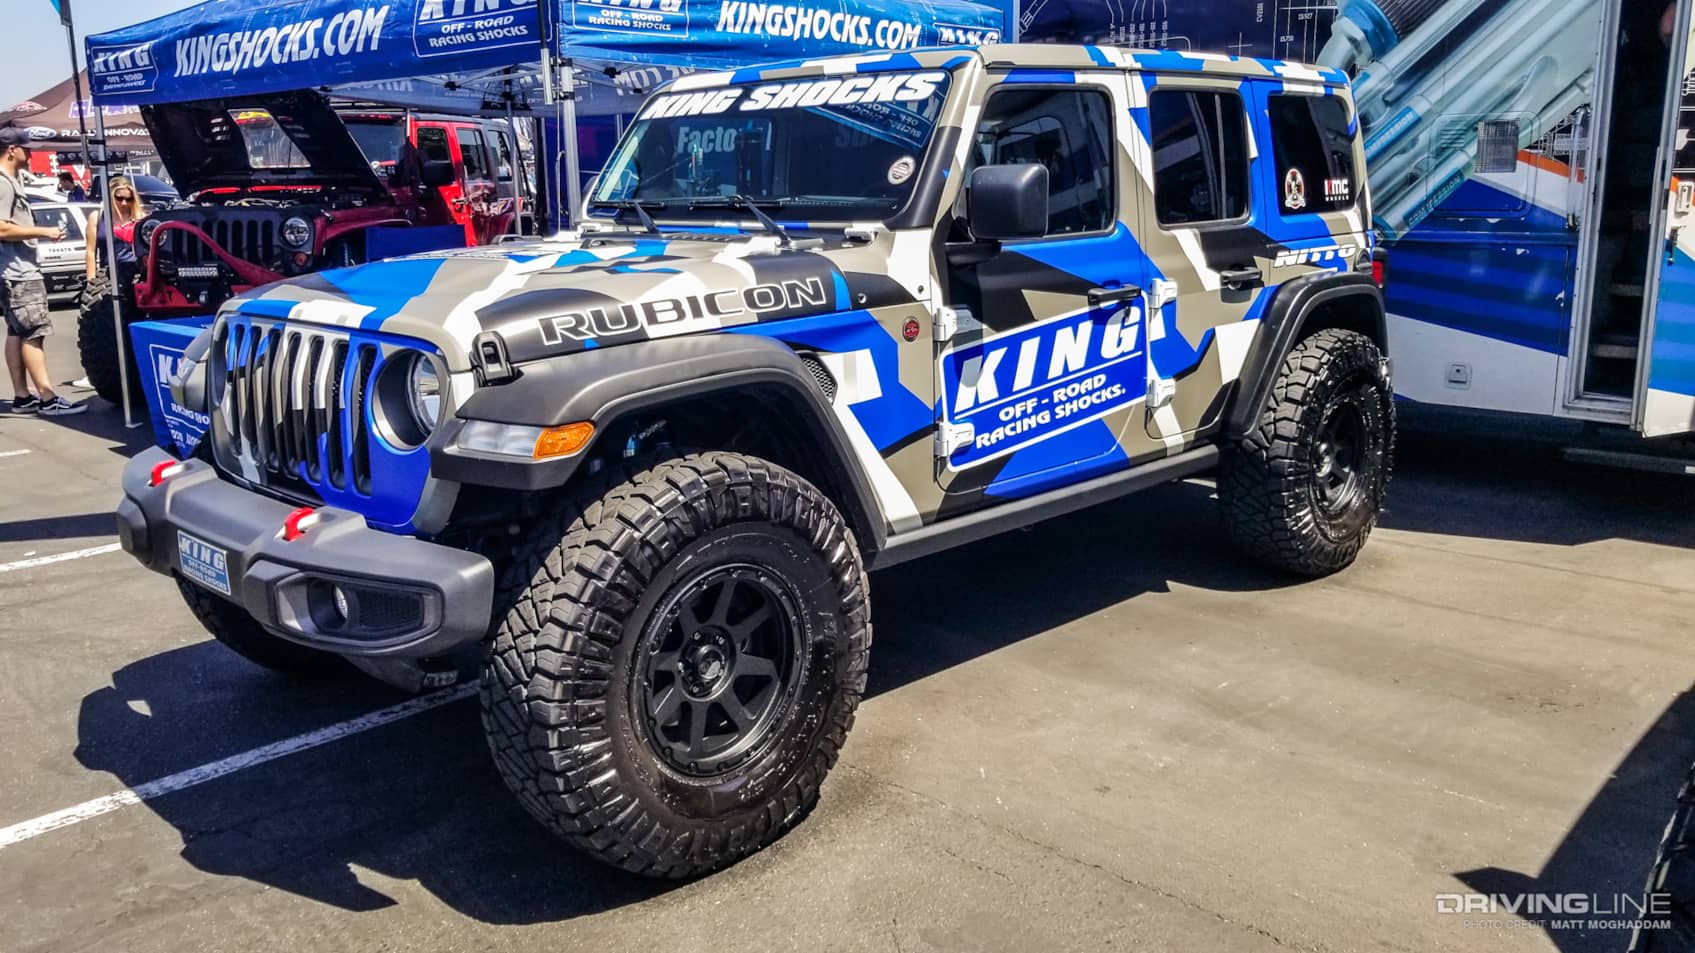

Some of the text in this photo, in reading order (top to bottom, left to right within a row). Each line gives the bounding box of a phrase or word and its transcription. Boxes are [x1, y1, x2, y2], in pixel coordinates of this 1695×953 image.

[419, 0, 537, 20] KIN
[441, 23, 465, 34] OFF
[474, 15, 514, 29] ROAD
[588, 16, 672, 31] RACING SHOCKS
[601, 9, 623, 19] OFF
[631, 12, 664, 22] ROAD
[716, 1, 921, 49] KINGSHOCKS.COM
[174, 5, 390, 77] KINGSHOCKS.COM
[428, 25, 529, 48] RACING SHOCKS
[639, 88, 745, 121] KING
[740, 71, 947, 111] SHOCKS
[61, 128, 97, 137] RALY
[677, 126, 741, 153] Facto
[1273, 243, 1357, 267] NITTO
[537, 276, 828, 347] RUBICON
[954, 306, 1141, 413] KING
[998, 397, 1038, 422] OFF
[1053, 373, 1107, 403] ROAD
[975, 409, 1051, 449] RACING
[181, 536, 225, 571] KING
